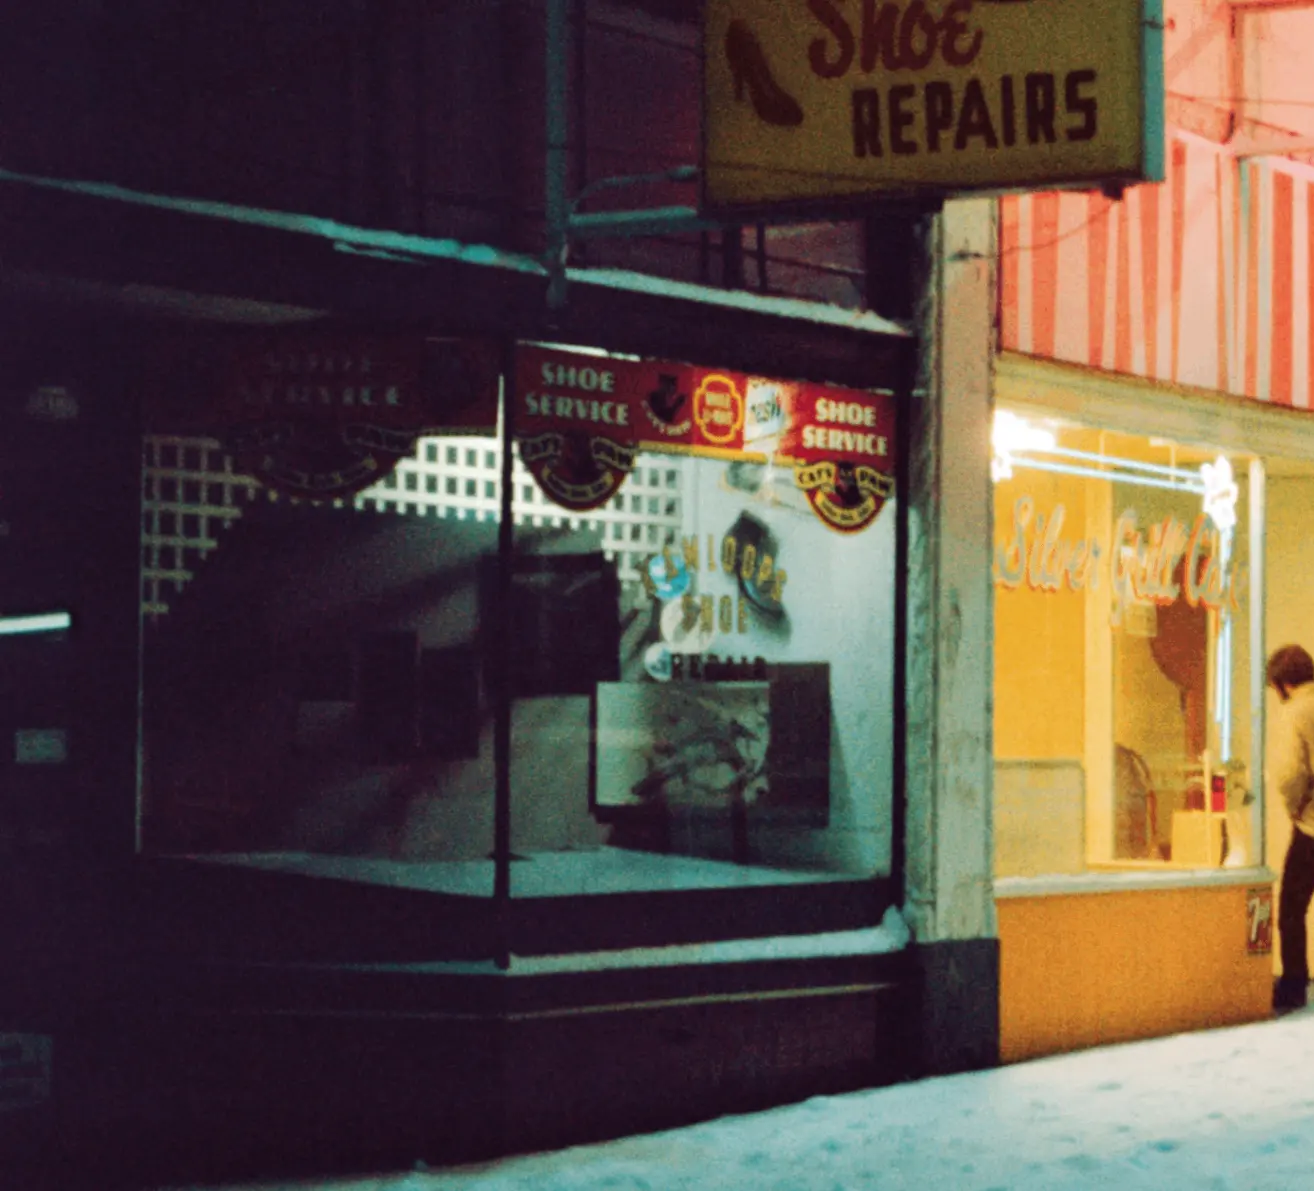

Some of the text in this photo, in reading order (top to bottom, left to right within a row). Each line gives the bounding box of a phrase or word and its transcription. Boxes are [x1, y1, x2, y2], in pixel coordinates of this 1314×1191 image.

[852, 69, 1097, 159] REPAIRS
[541, 361, 614, 393] SHOE
[525, 391, 630, 426] SERVICE
[815, 396, 877, 428] SHOE
[802, 424, 889, 457] SERVICE
[991, 494, 1100, 592] Silver
